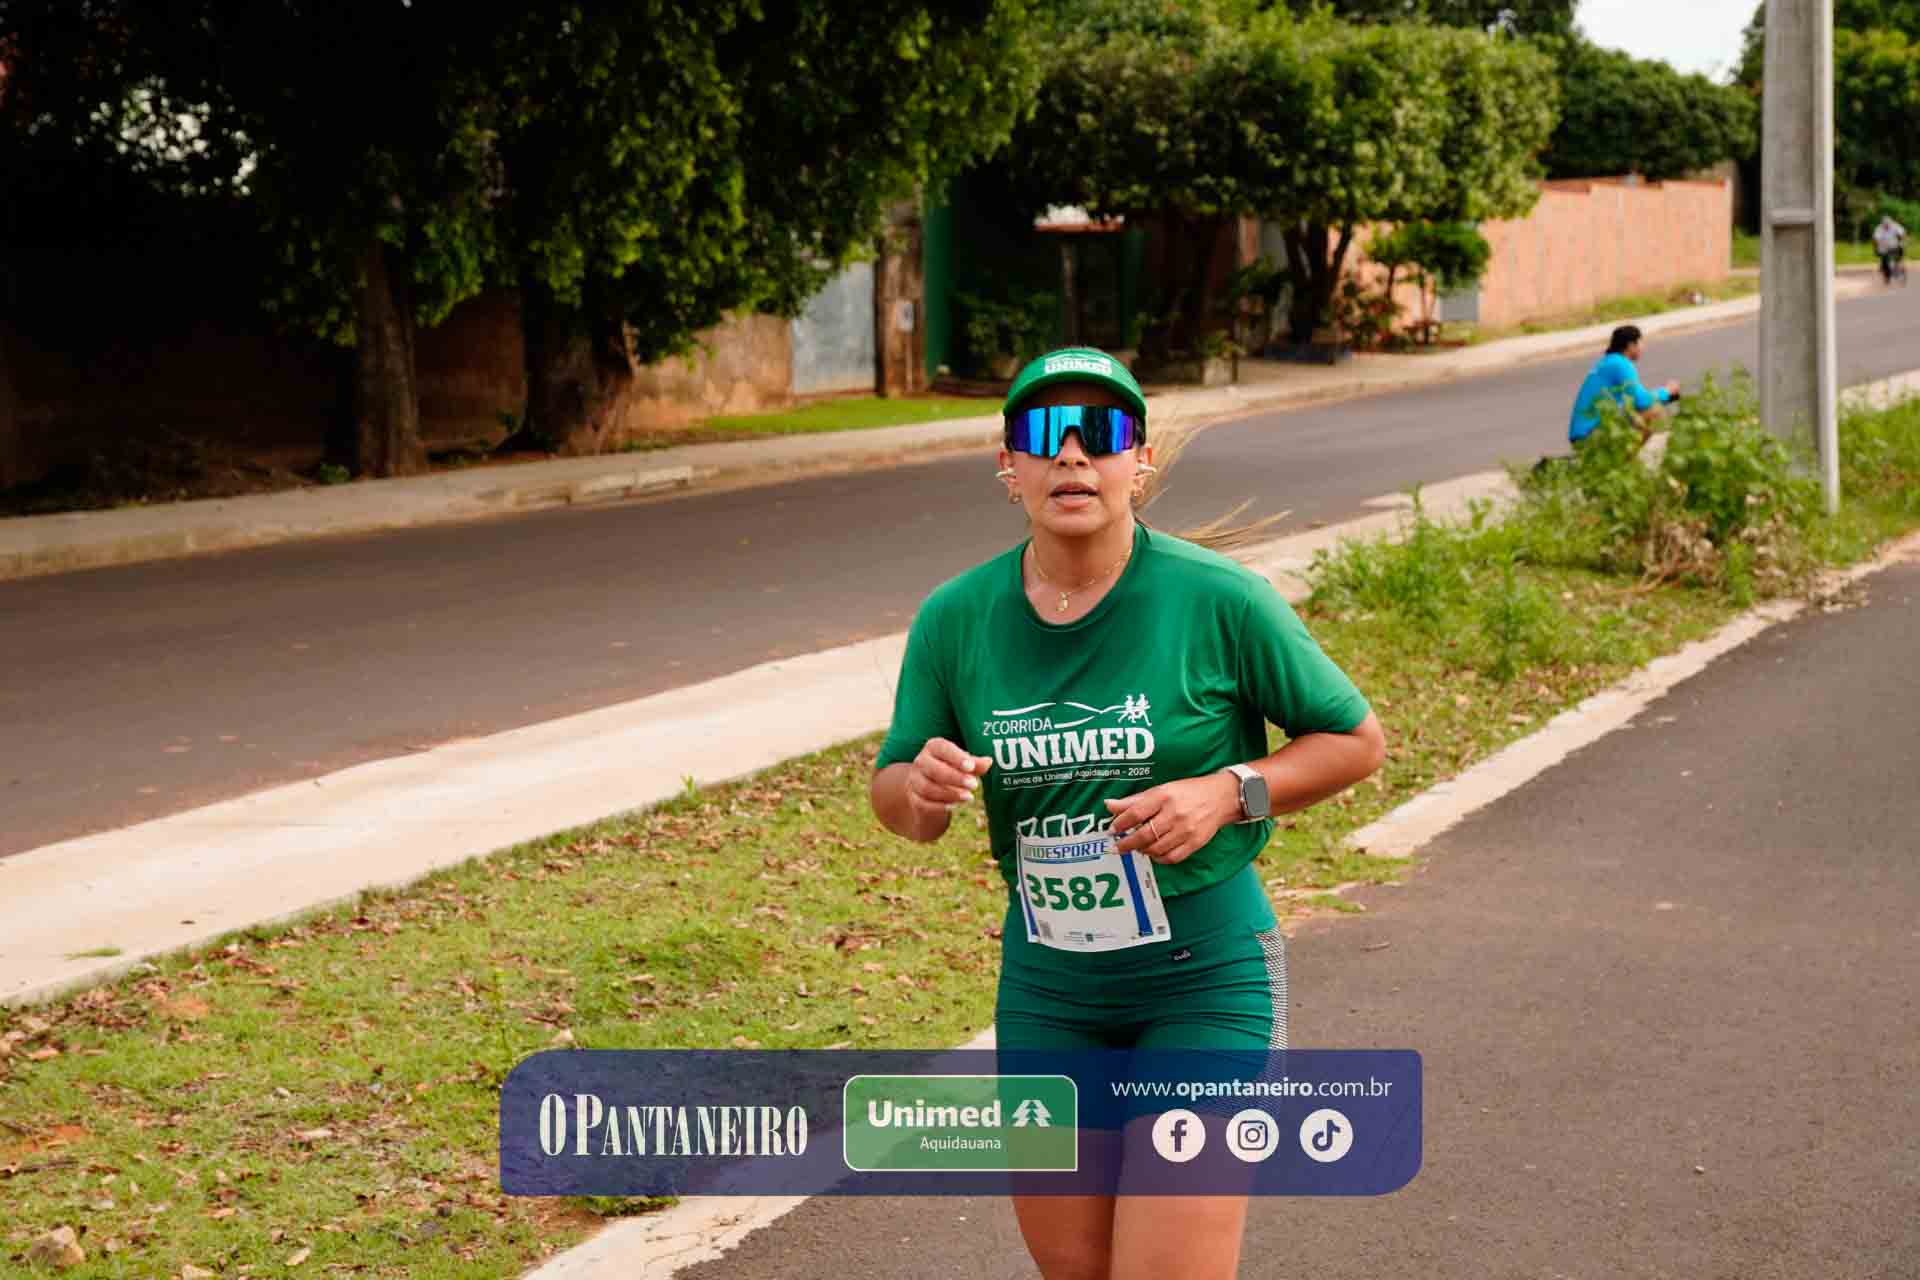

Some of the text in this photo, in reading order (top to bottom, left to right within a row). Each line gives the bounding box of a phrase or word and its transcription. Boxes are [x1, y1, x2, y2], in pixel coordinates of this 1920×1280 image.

[992, 717, 1053, 736] CORRIDA
[992, 727, 1155, 770] UNIMED
[1128, 767, 1151, 777] 2026
[1025, 873, 1125, 911] 3582
